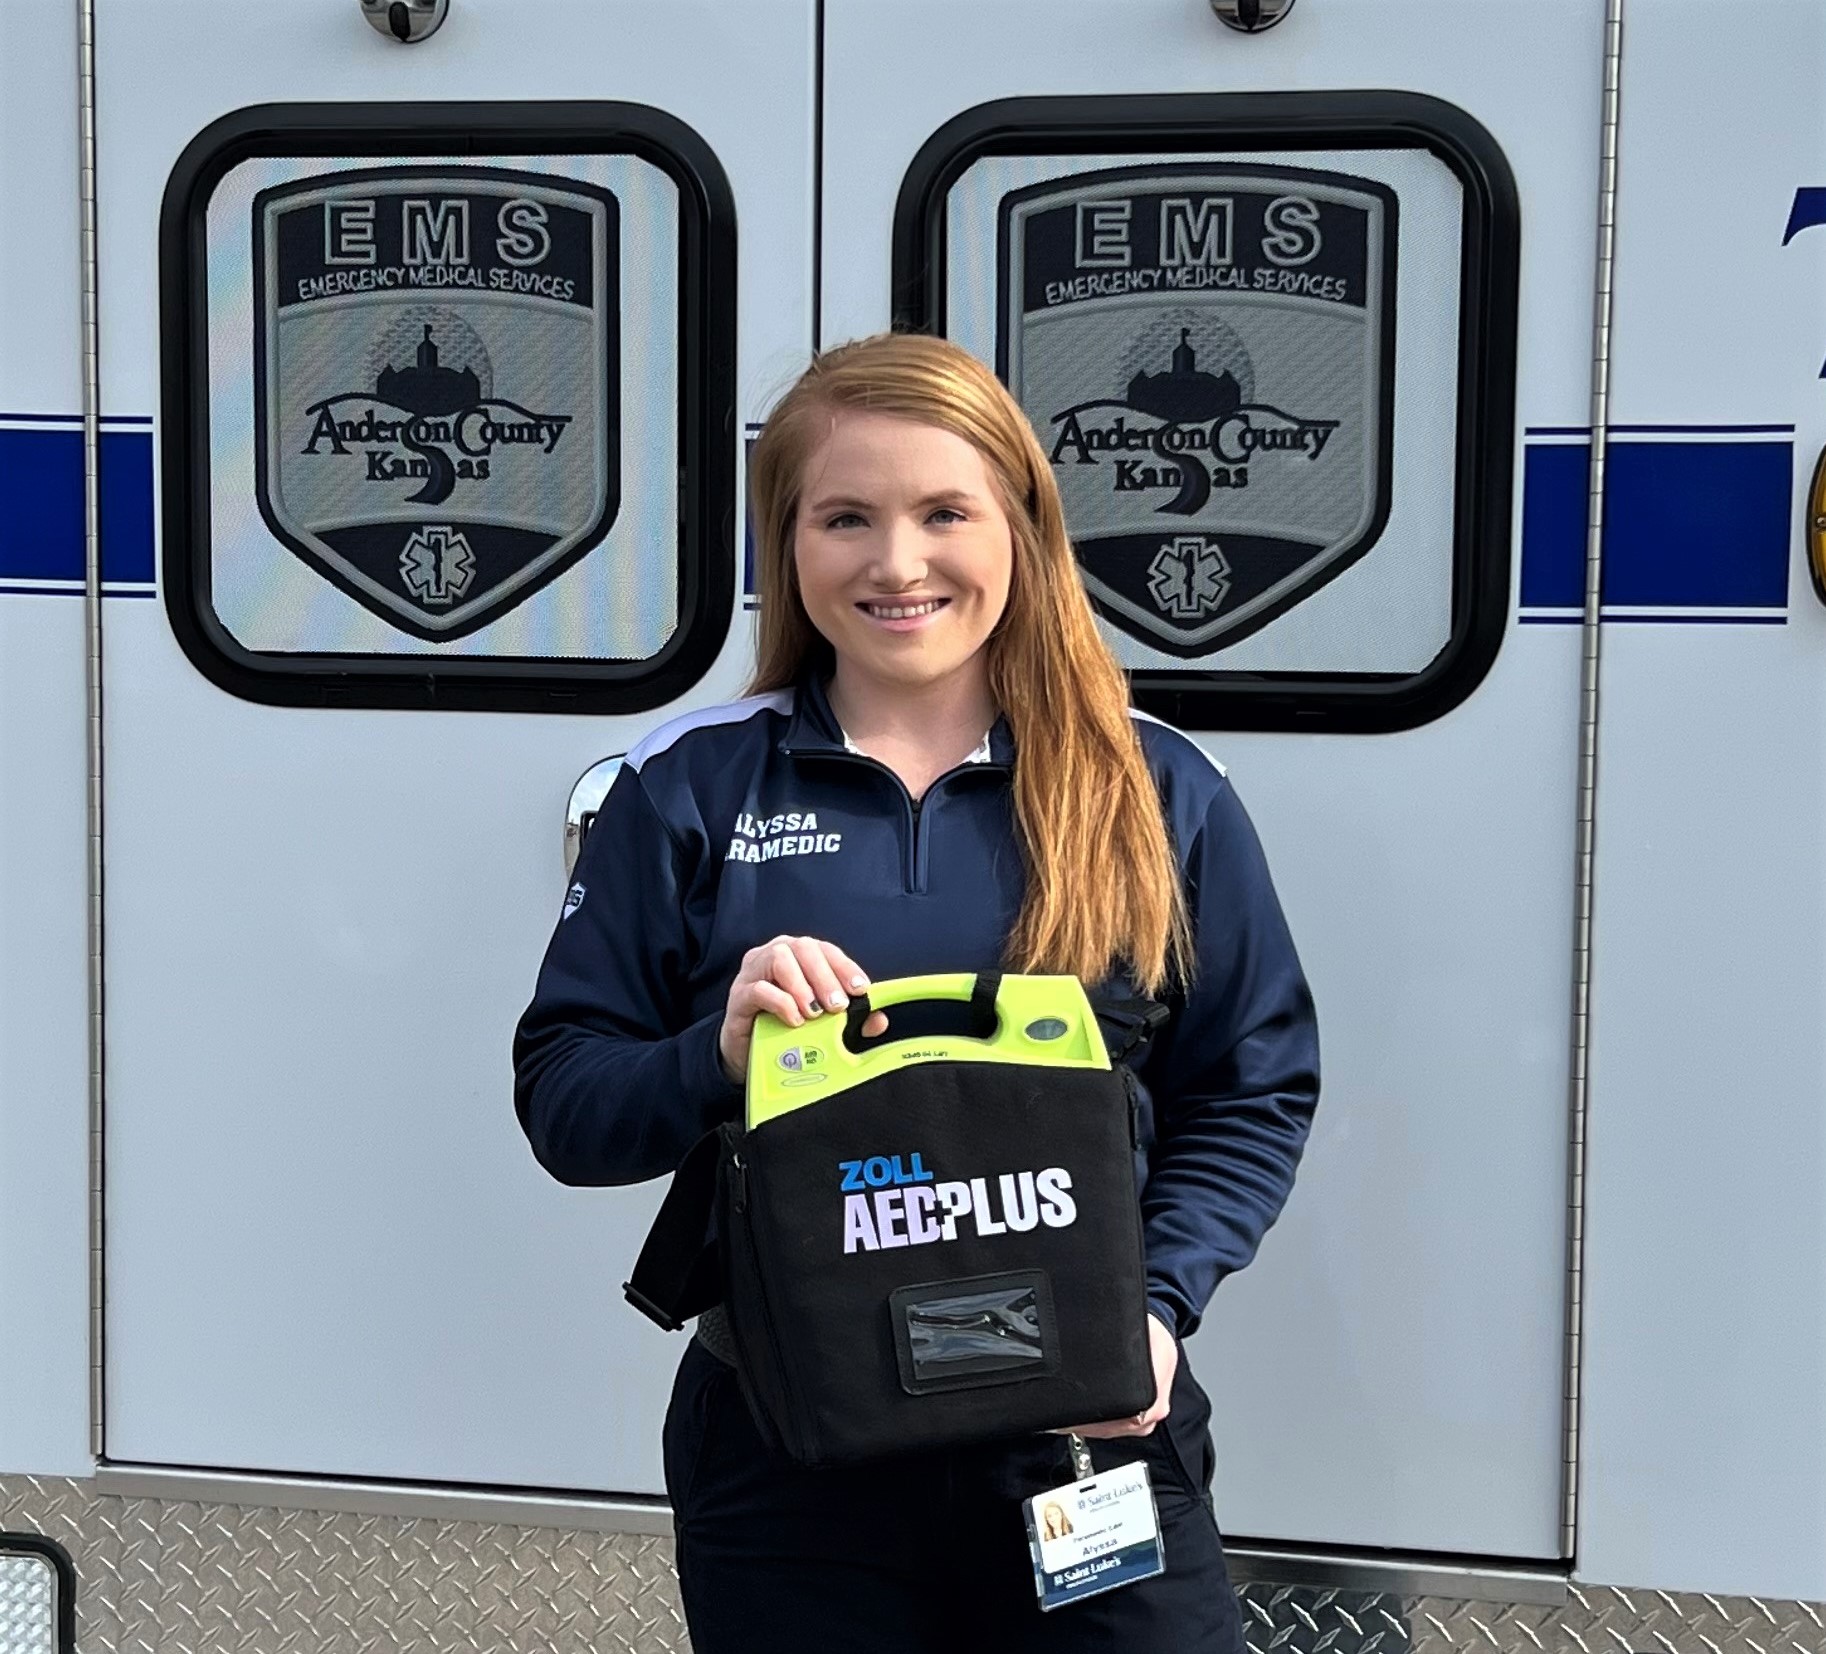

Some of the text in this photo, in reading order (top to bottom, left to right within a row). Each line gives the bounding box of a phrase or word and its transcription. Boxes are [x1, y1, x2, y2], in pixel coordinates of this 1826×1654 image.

[298, 266, 576, 300] EMERGENCY MEDICAL SERVICES
[1045, 267, 1347, 304] EMERGENCY MEDICAL SERVICES
[453, 407, 566, 456] County
[1210, 413, 1334, 465] County
[725, 833, 842, 863] RAMEDIC
[838, 1152, 934, 1191] ZOLL
